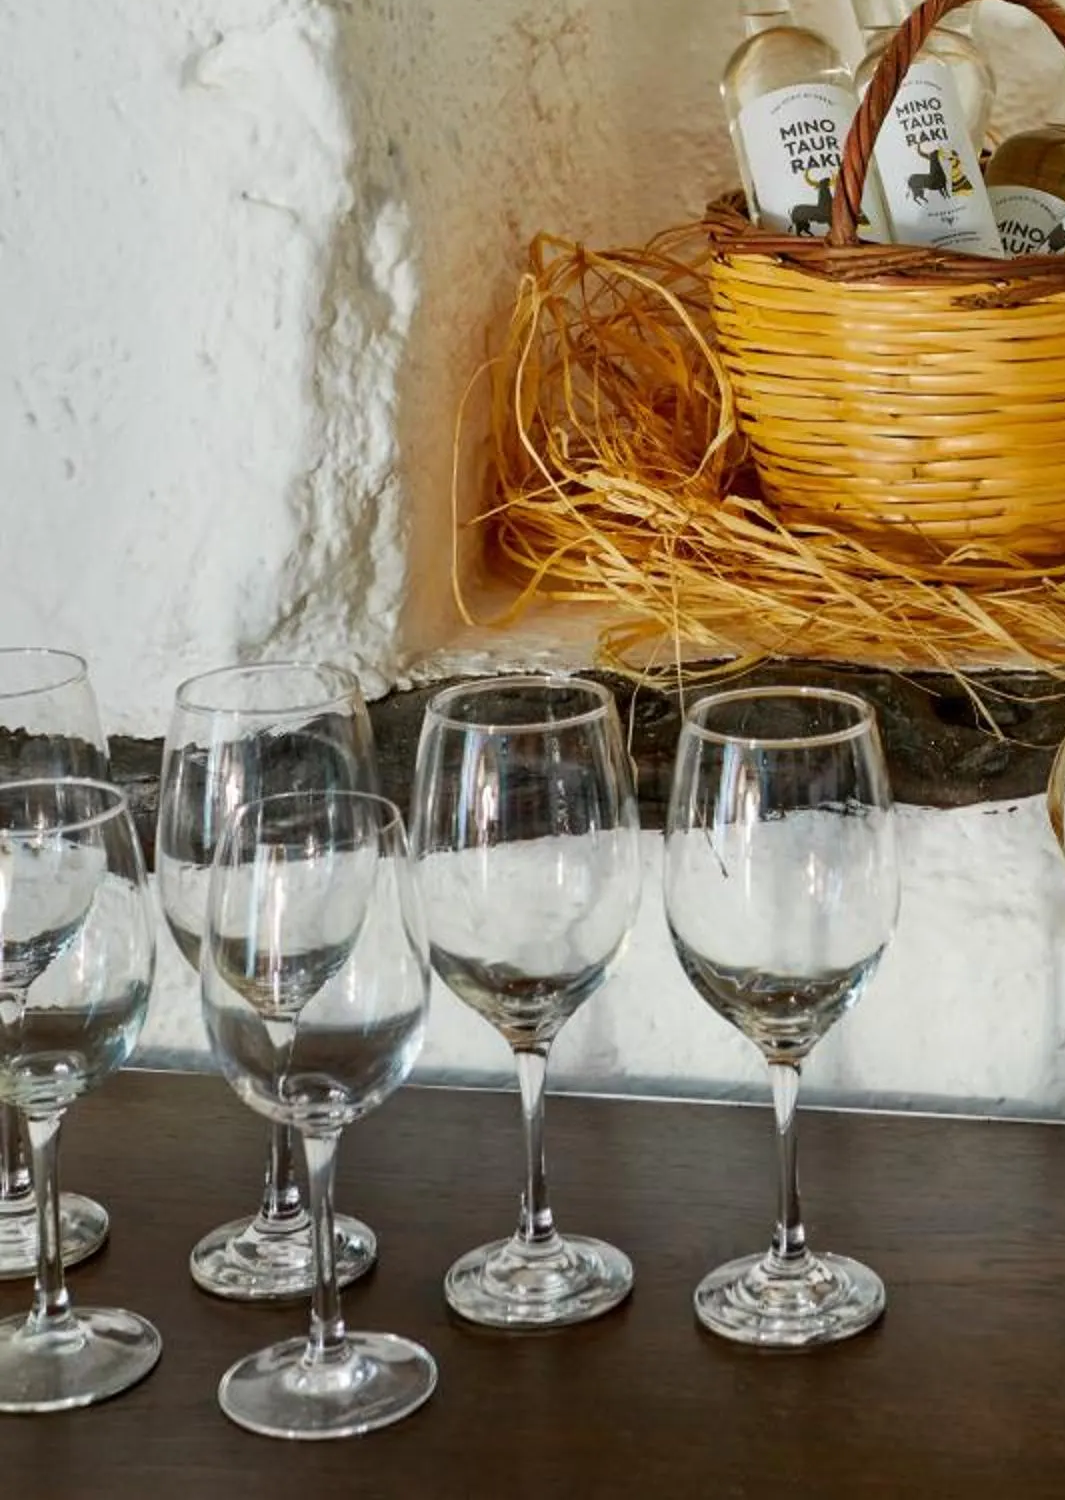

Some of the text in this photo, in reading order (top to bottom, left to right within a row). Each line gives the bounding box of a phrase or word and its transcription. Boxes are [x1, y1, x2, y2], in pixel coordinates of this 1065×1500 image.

[896, 97, 943, 118] MINO
[779, 118, 836, 141] MINO
[900, 113, 945, 131] TAUR
[783, 136, 840, 157] TAUR
[906, 128, 948, 147] RAKI
[790, 153, 842, 175] RAKI
